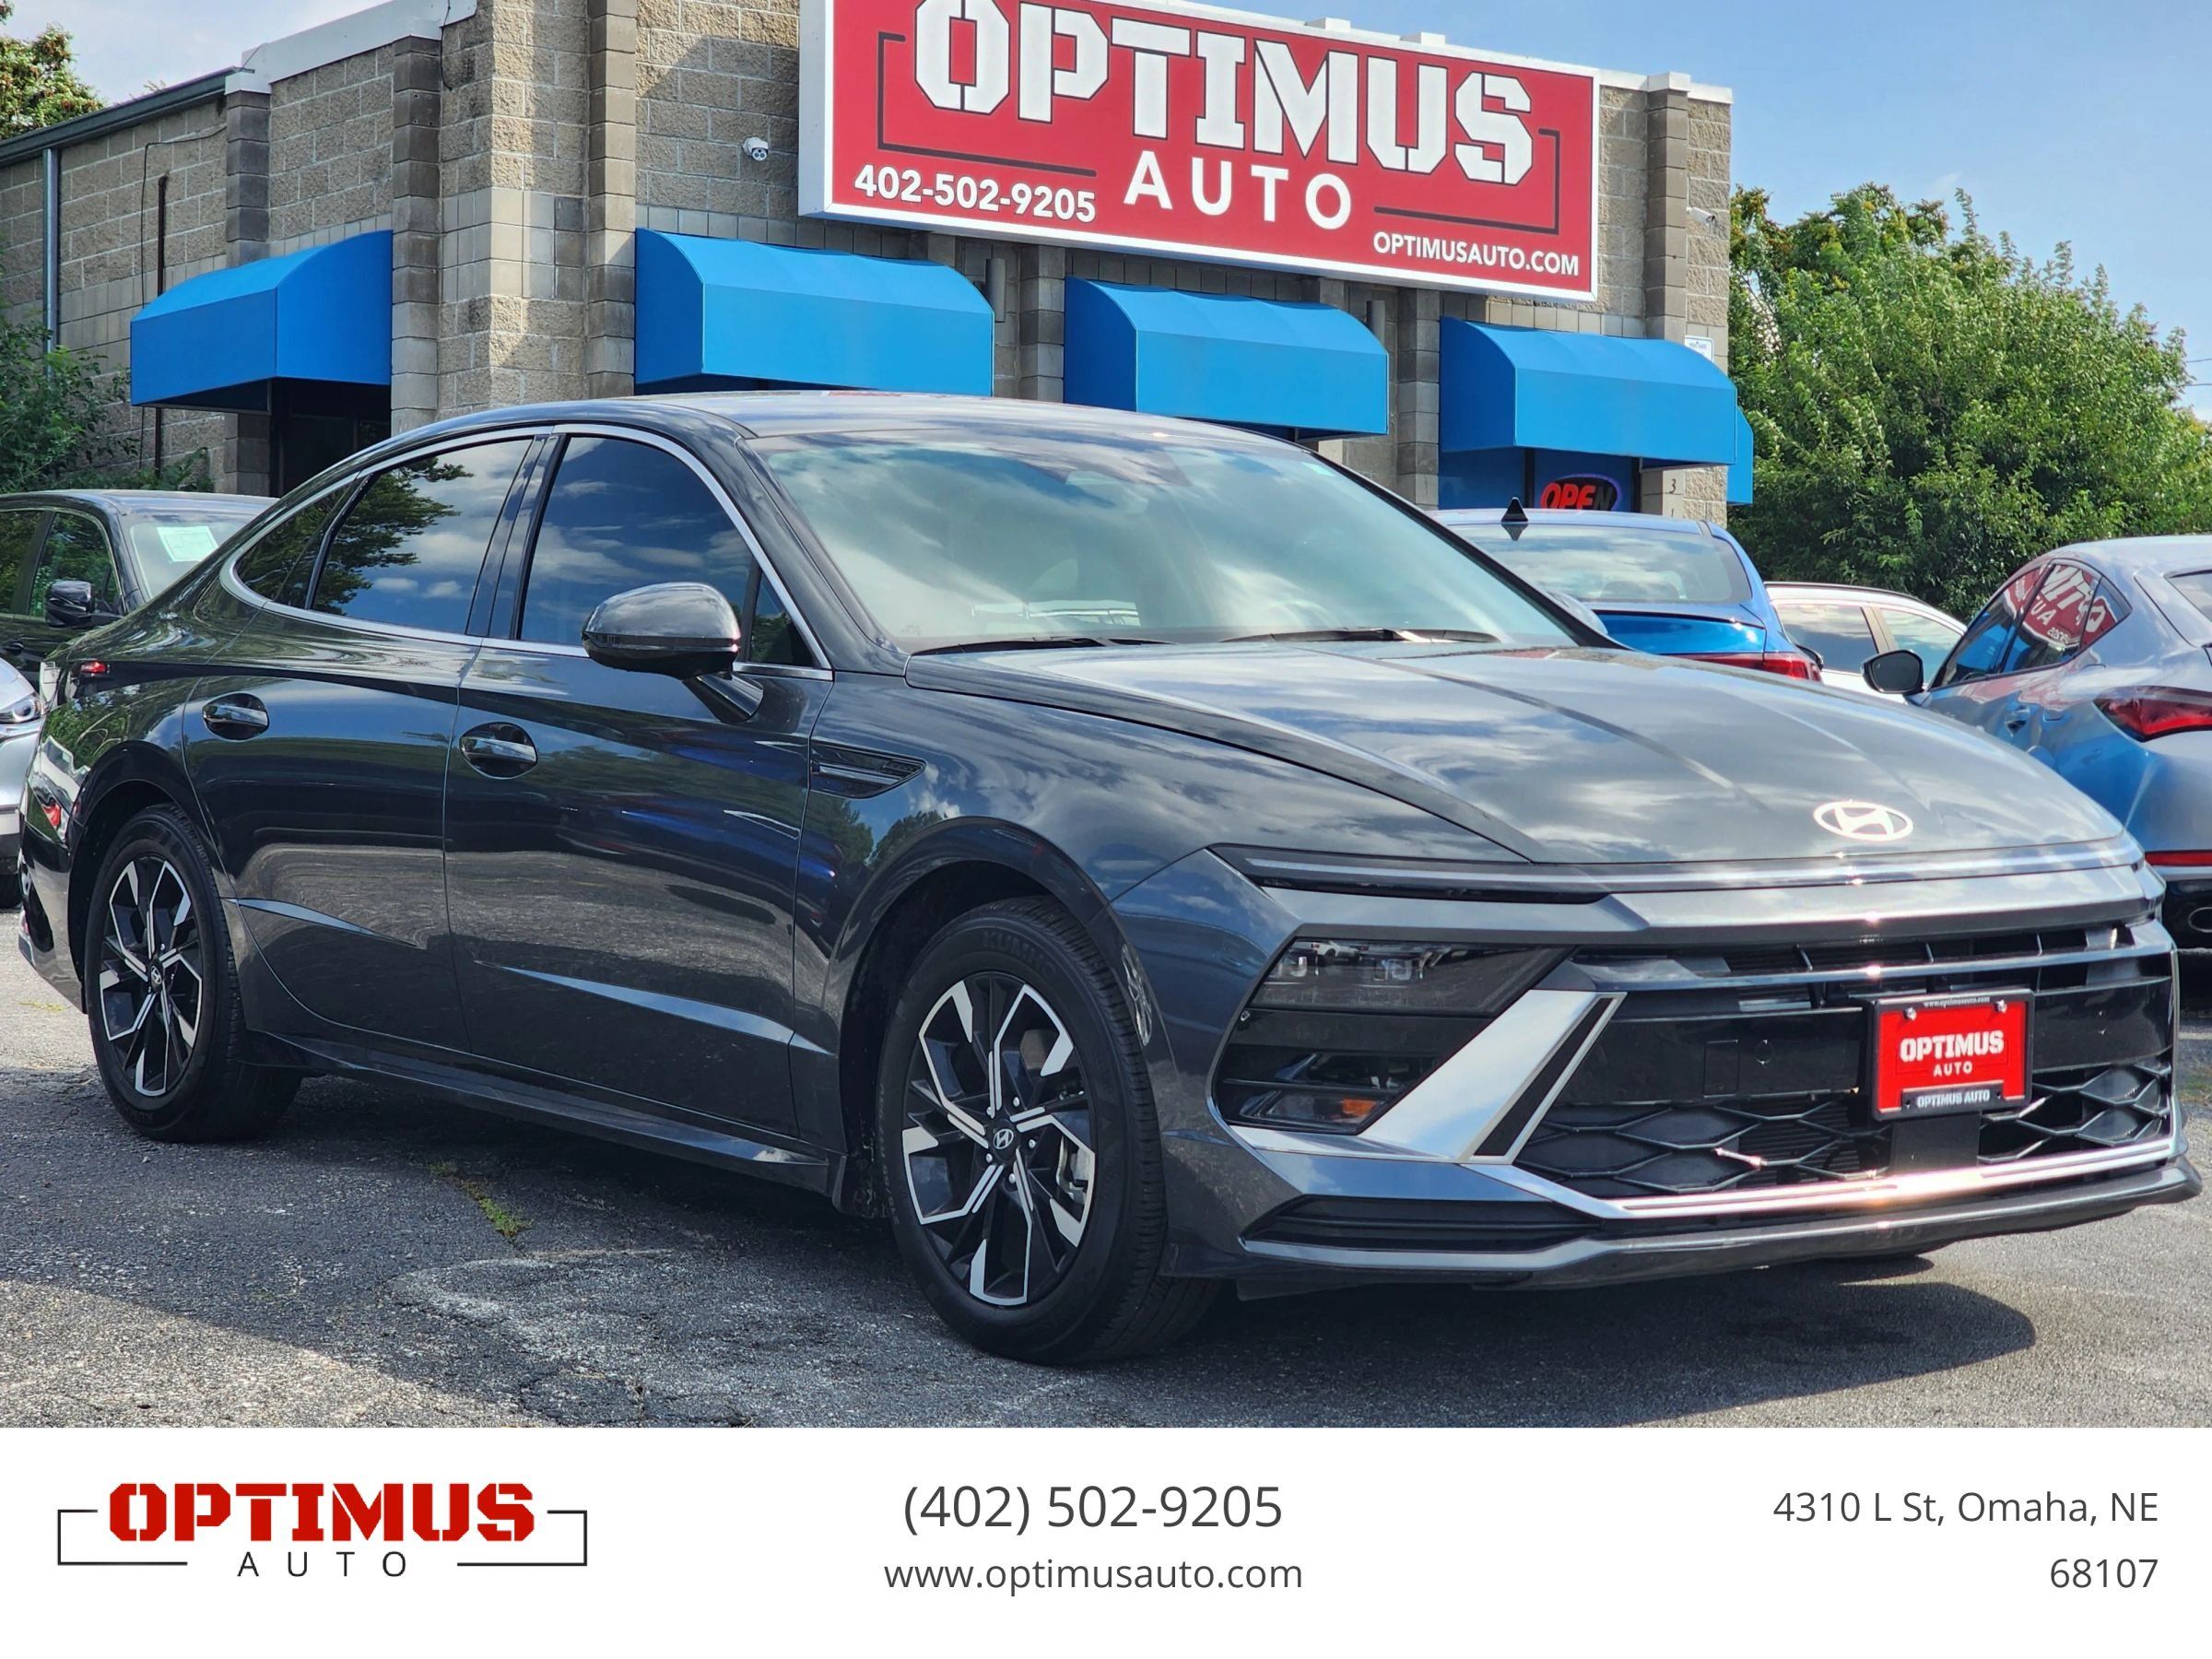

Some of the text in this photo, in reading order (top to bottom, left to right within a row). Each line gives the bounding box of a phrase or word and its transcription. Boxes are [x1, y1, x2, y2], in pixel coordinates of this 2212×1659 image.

[914, 0, 1533, 185] OPTIMUS
[853, 163, 1098, 223] 402-502-9205
[1123, 150, 1352, 230] AUTO
[1372, 230, 1580, 276] OPTIMUSAUTO.COM
[1900, 1030, 2005, 1063] OPTIMUS
[1933, 1061, 1973, 1077] AUTO
[1917, 1088, 1991, 1109] OPTIMUS AUTO
